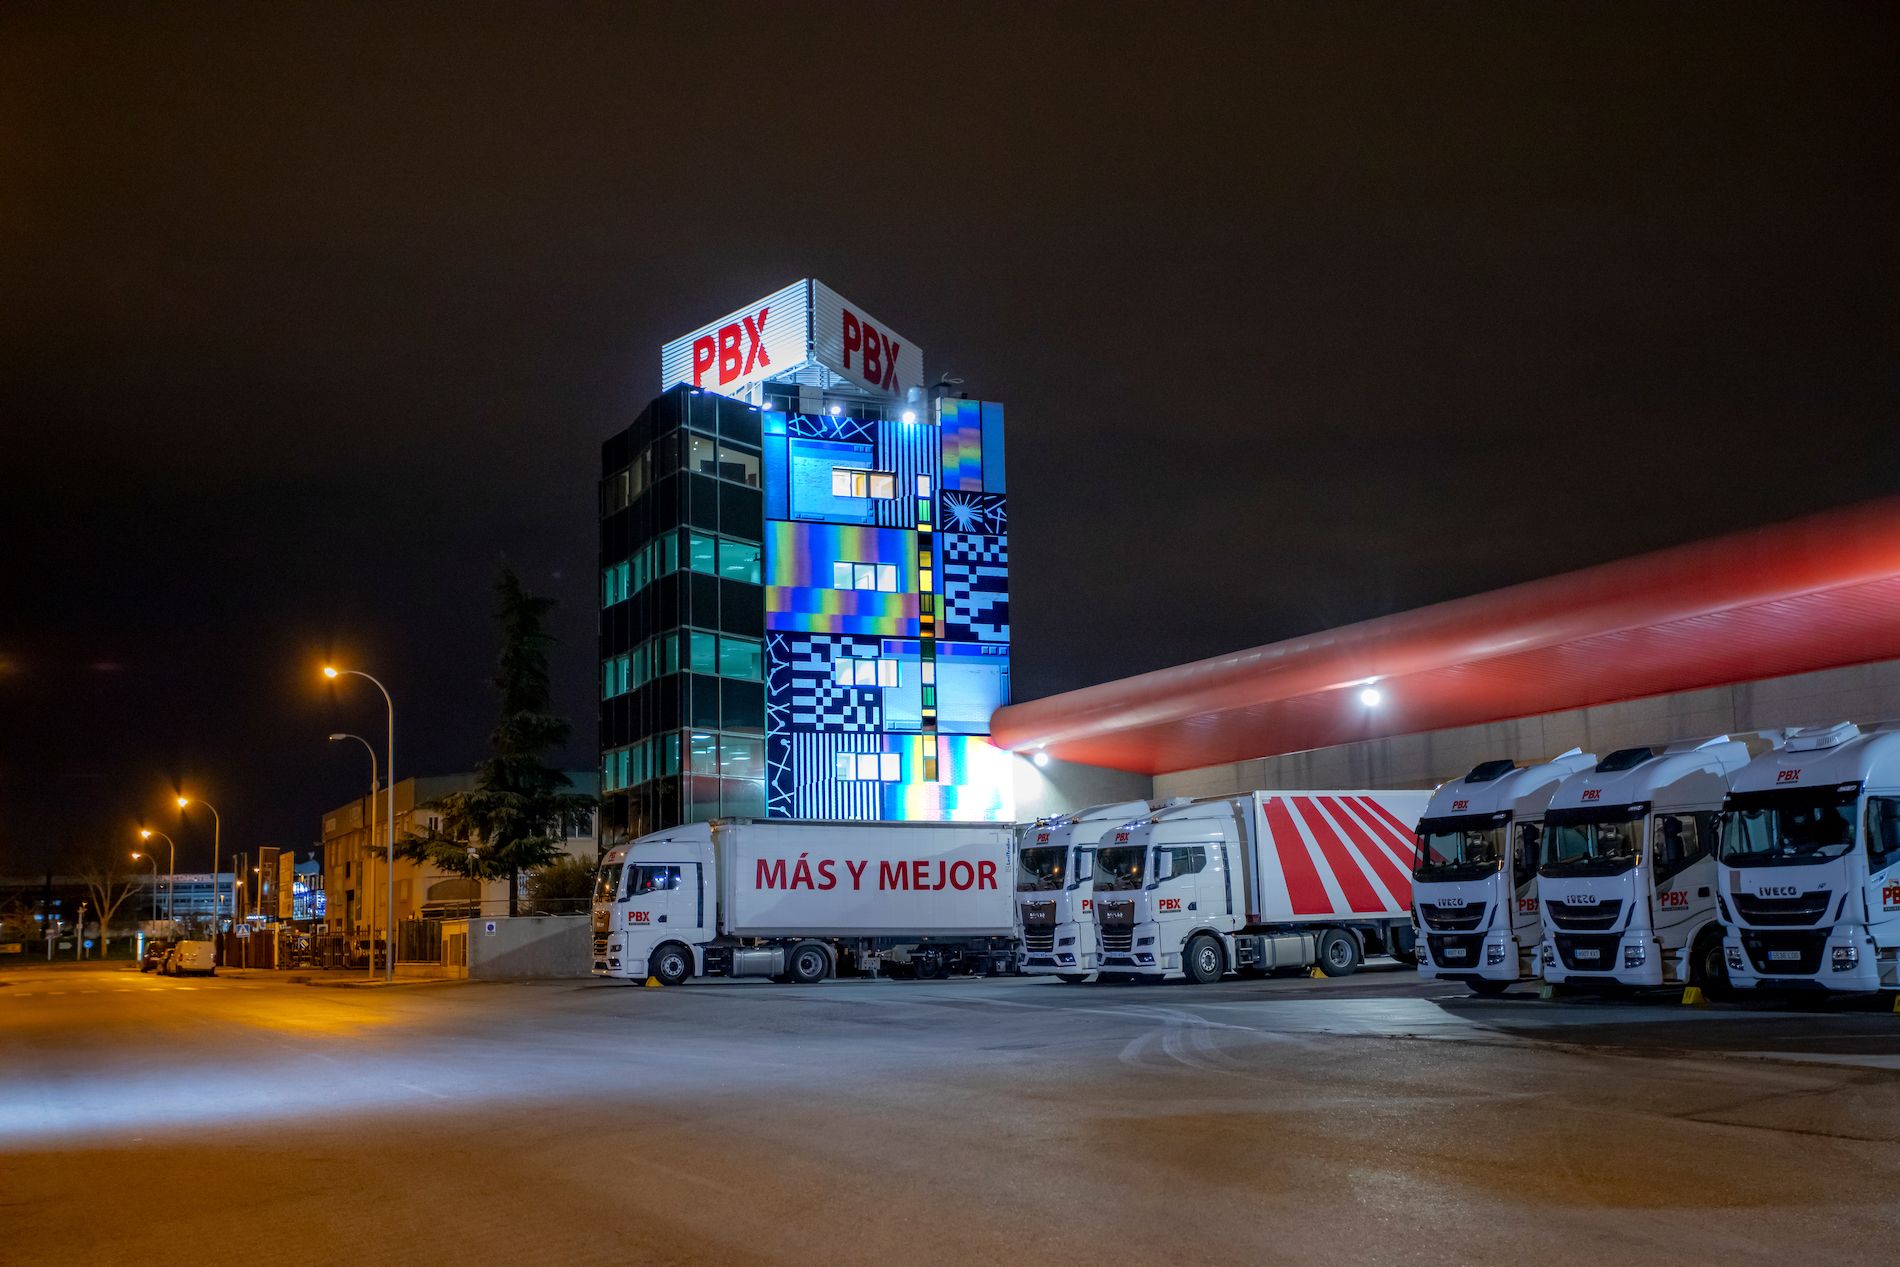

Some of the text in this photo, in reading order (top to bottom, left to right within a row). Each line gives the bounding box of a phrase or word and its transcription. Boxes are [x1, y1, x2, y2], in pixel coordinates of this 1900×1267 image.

[693, 308, 771, 388] PBX
[843, 308, 901, 395] PBX
[1777, 769, 1801, 781] PBX
[1581, 789, 1602, 800] PBX
[1452, 800, 1469, 809] PBX
[1037, 833, 1050, 842] PBX
[1115, 832, 1130, 842] PBX
[755, 852, 998, 891] MÁS Y MEJOR
[1759, 886, 1797, 896] IVECO
[1159, 898, 1181, 910] PBX
[1519, 898, 1539, 911] PB
[1661, 891, 1689, 906] PBX
[628, 911, 650, 922] PBX
